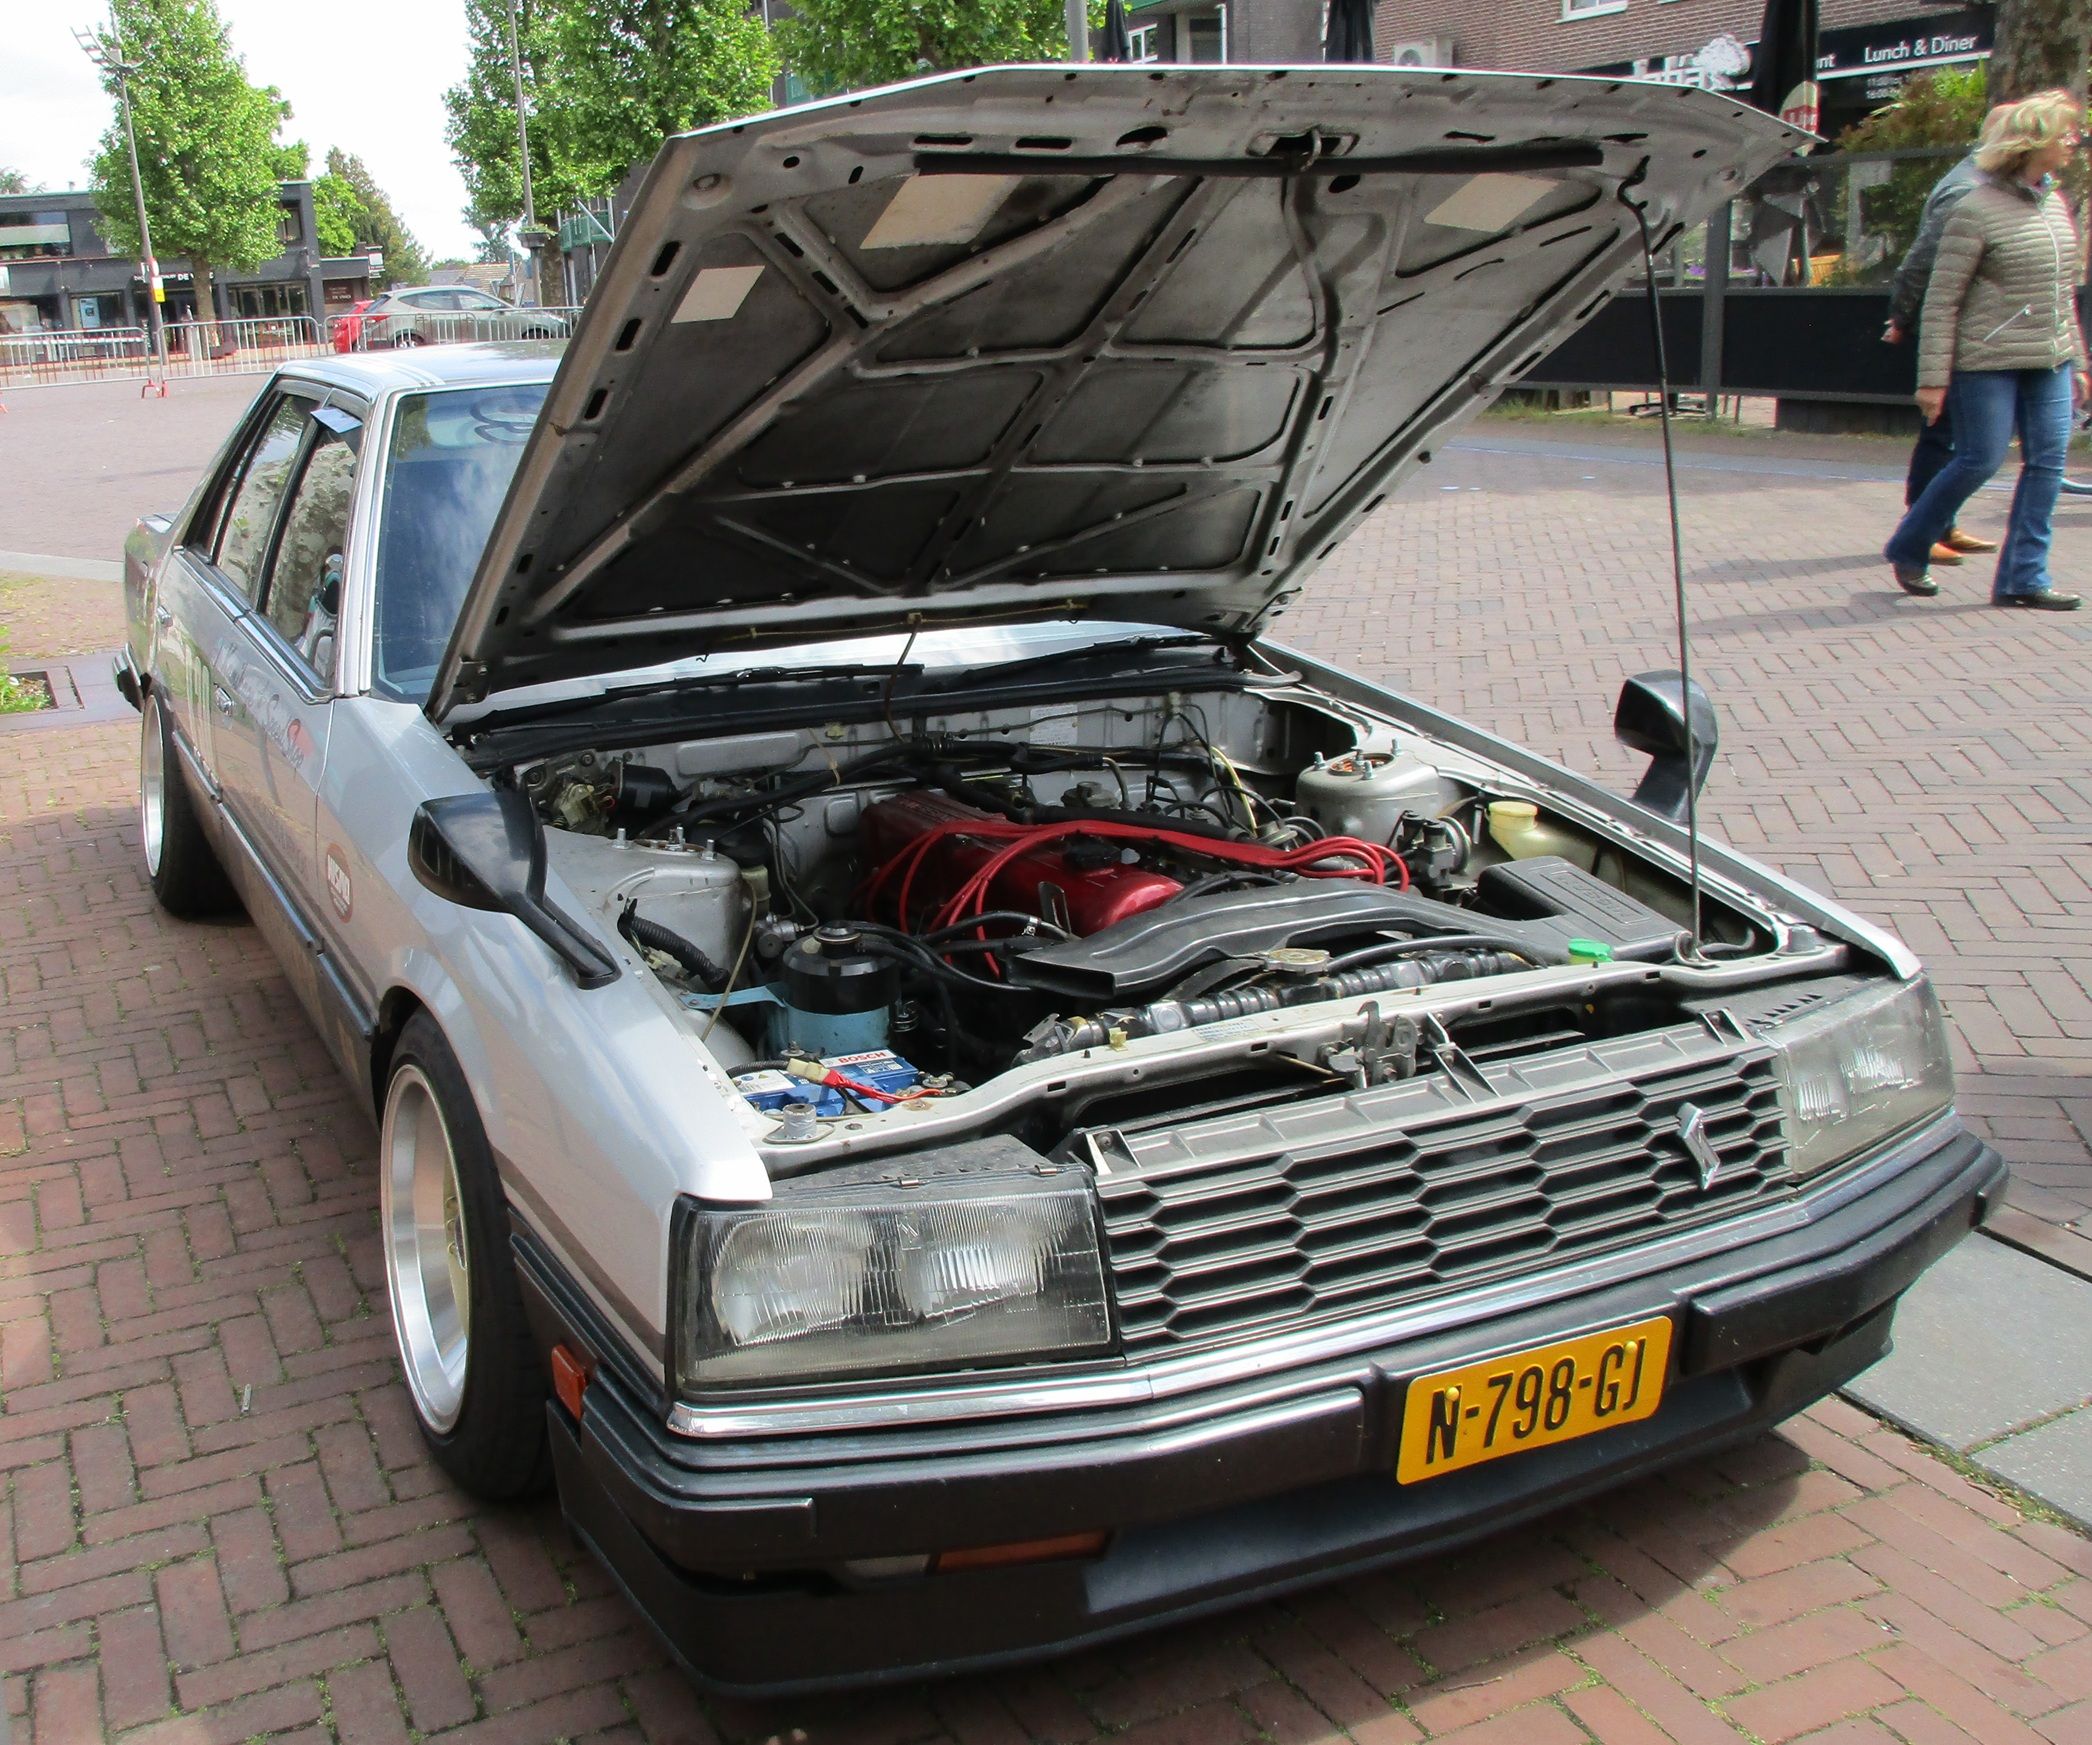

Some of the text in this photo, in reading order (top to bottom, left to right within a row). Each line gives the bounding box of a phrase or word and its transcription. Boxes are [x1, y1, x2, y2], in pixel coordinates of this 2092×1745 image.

[1864, 39, 1910, 63] Lunch
[1913, 38, 1928, 56] &
[1931, 34, 1977, 54] Diner
[838, 1052, 887, 1064] BOSCH
[1425, 1337, 1646, 1465] N-798-GJ
